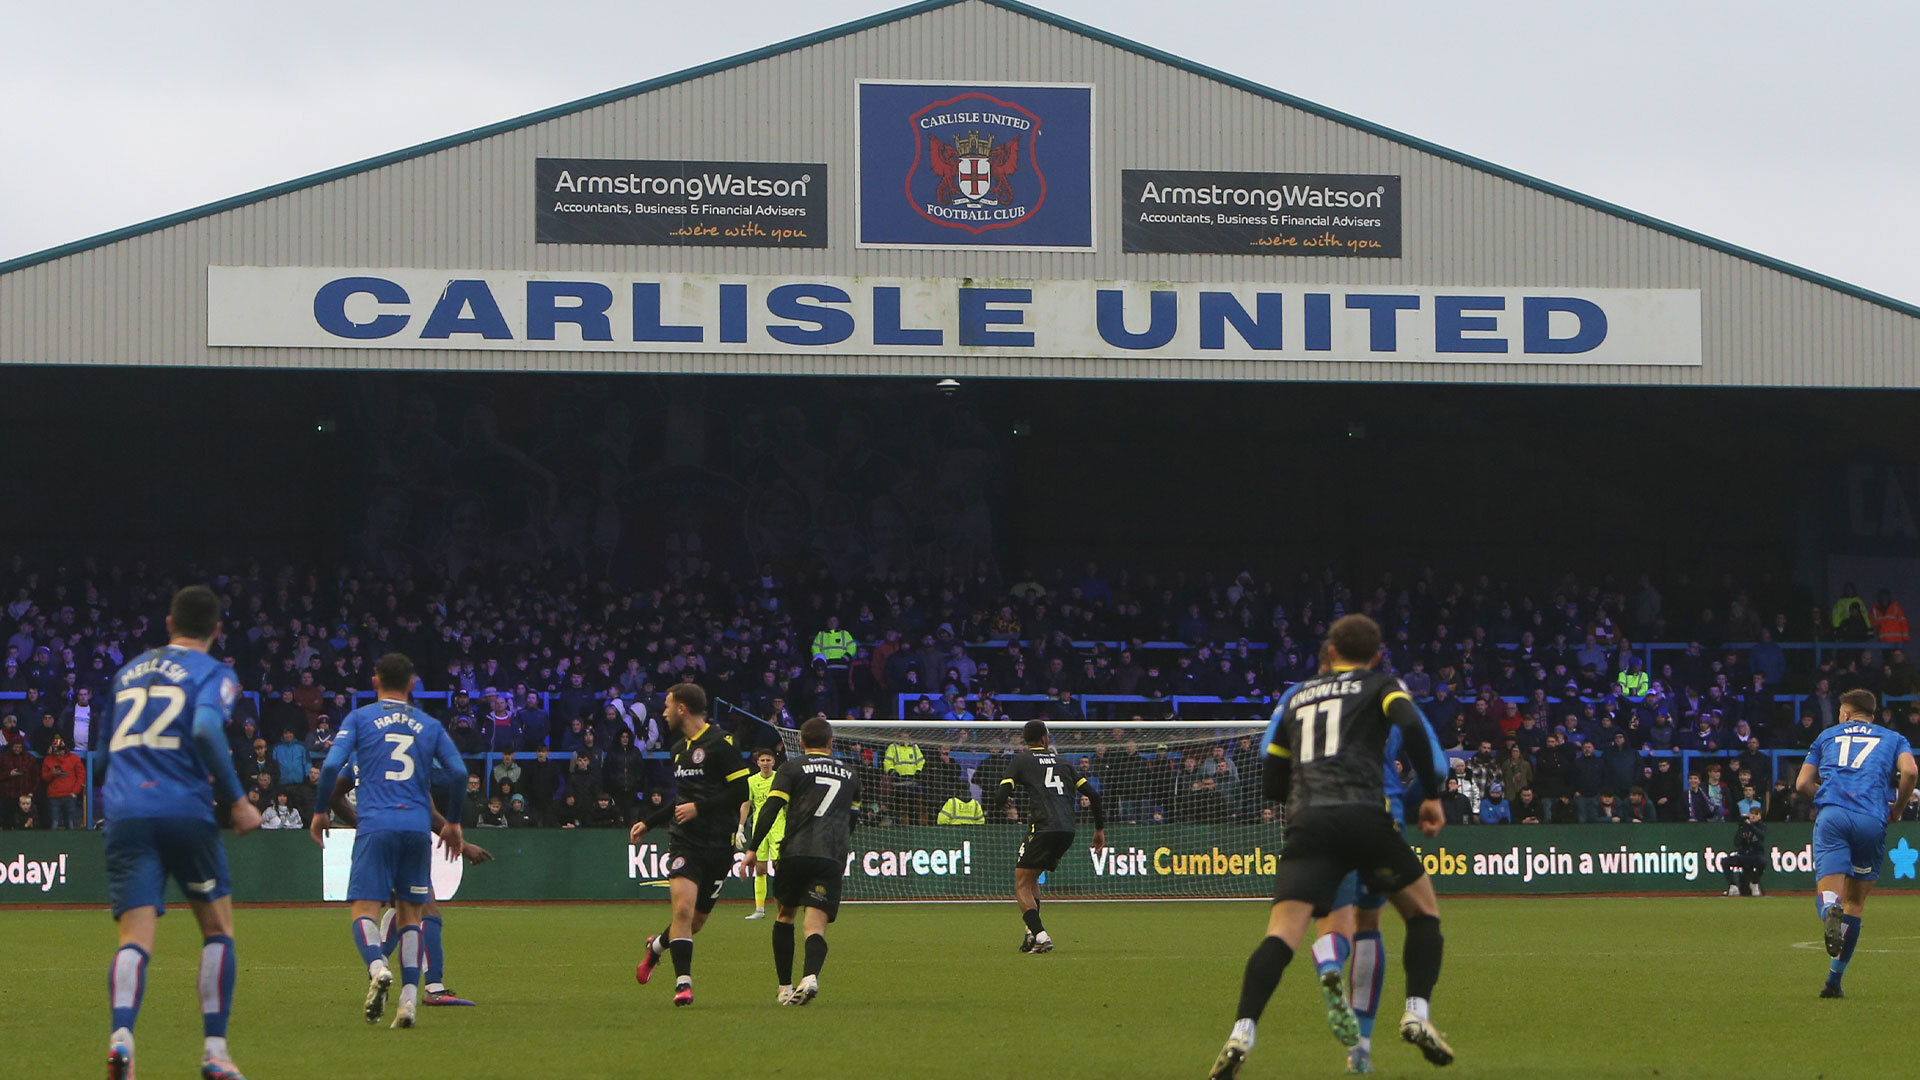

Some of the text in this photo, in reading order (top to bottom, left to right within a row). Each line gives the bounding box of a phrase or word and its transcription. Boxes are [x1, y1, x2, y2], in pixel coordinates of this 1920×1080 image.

[920, 112, 1031, 131] CARLISLE UNITED
[554, 201, 806, 217] Accountants, Business & Financial Advisers
[926, 204, 1026, 220] FOOTBALL CLUB
[1140, 212, 1381, 227] Accountants, Business & Financial Advisers
[725, 221, 766, 237] with
[772, 229, 807, 243] you
[1303, 231, 1342, 247] with
[1347, 239, 1382, 252] you
[313, 275, 1609, 355] CARLISLE UNITED
[1289, 680, 1362, 710] KNOWLES
[109, 685, 186, 753] 22
[373, 712, 424, 734] HARPER
[1295, 698, 1343, 764] 11
[384, 733, 415, 781] 3
[1834, 735, 1881, 769] 17
[802, 763, 852, 780] WHALLEY
[1044, 766, 1065, 795] 4
[814, 776, 841, 817] 7
[862, 841, 971, 877] career!
[1089, 846, 1147, 876] Visit
[1153, 846, 1282, 876] Cumberla
[1473, 846, 1519, 876] and
[1523, 846, 1573, 882] join
[1578, 852, 1593, 875] a
[1598, 845, 1699, 881] winning
[1770, 844, 1815, 873] tod
